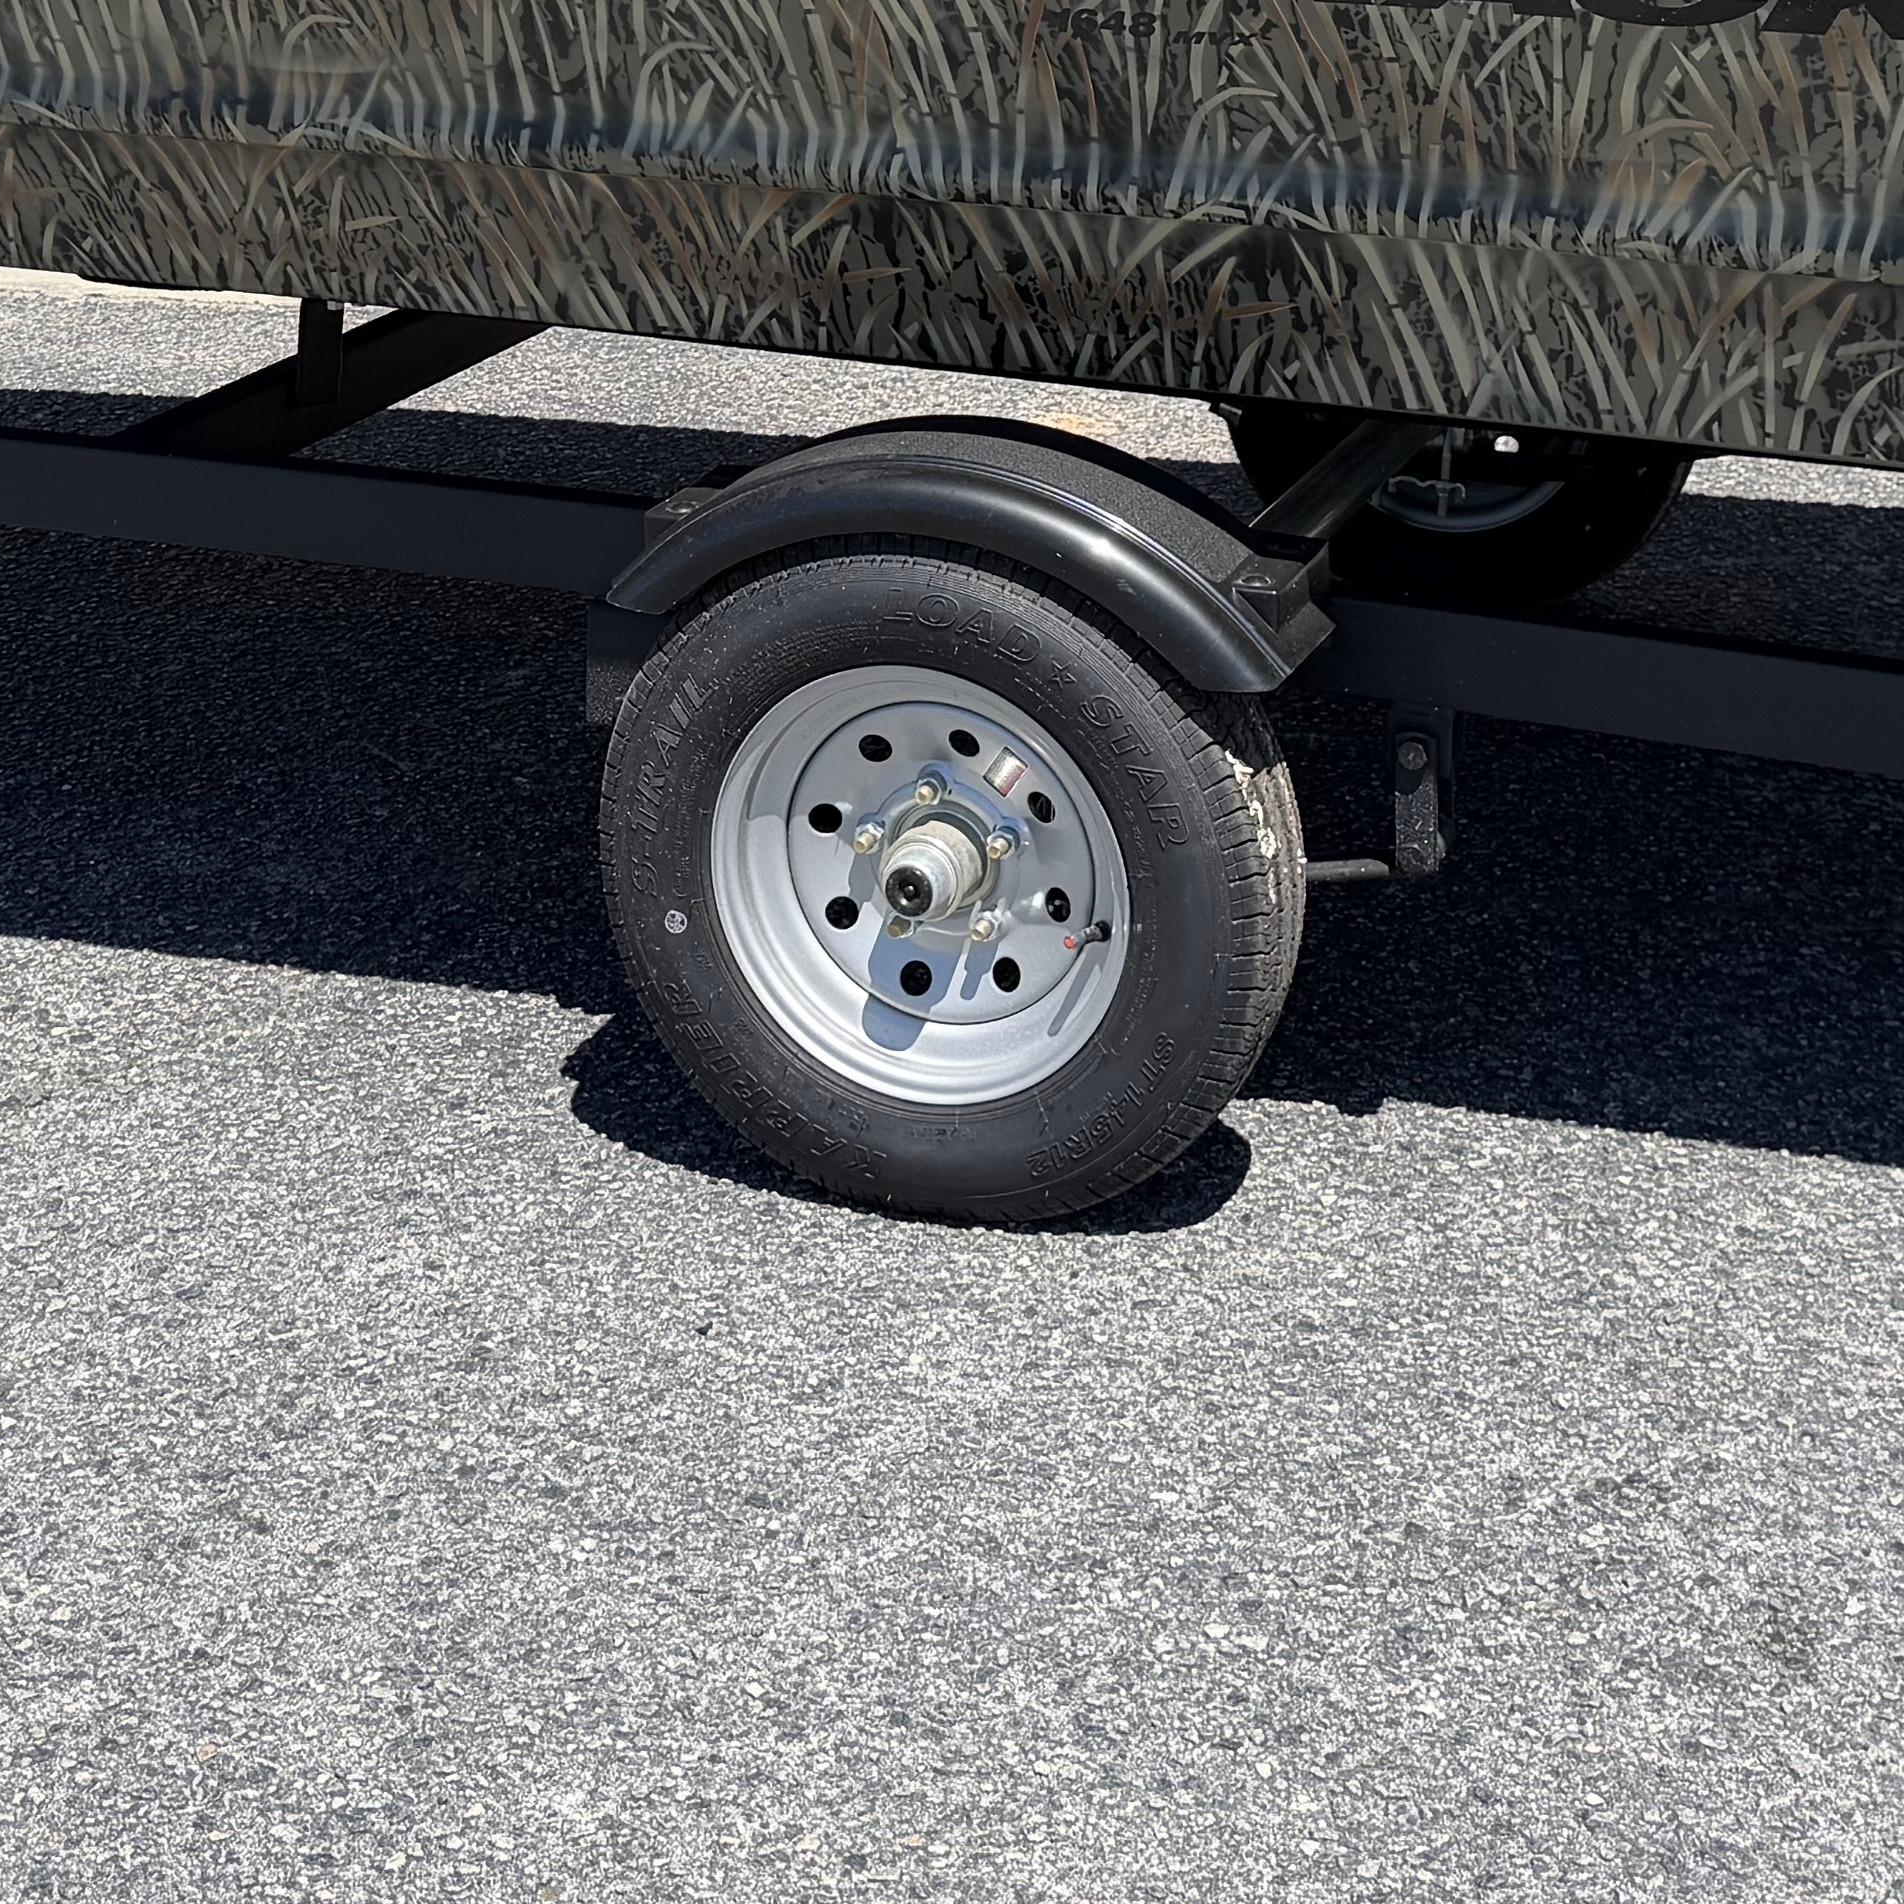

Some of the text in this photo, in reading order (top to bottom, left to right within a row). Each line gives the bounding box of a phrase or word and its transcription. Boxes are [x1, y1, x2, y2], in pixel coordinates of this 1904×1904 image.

[1046, 6, 1158, 40] 1648
[883, 587, 1191, 849] LOAD STAR
[1026, 1031, 1176, 1177] ST145R12
